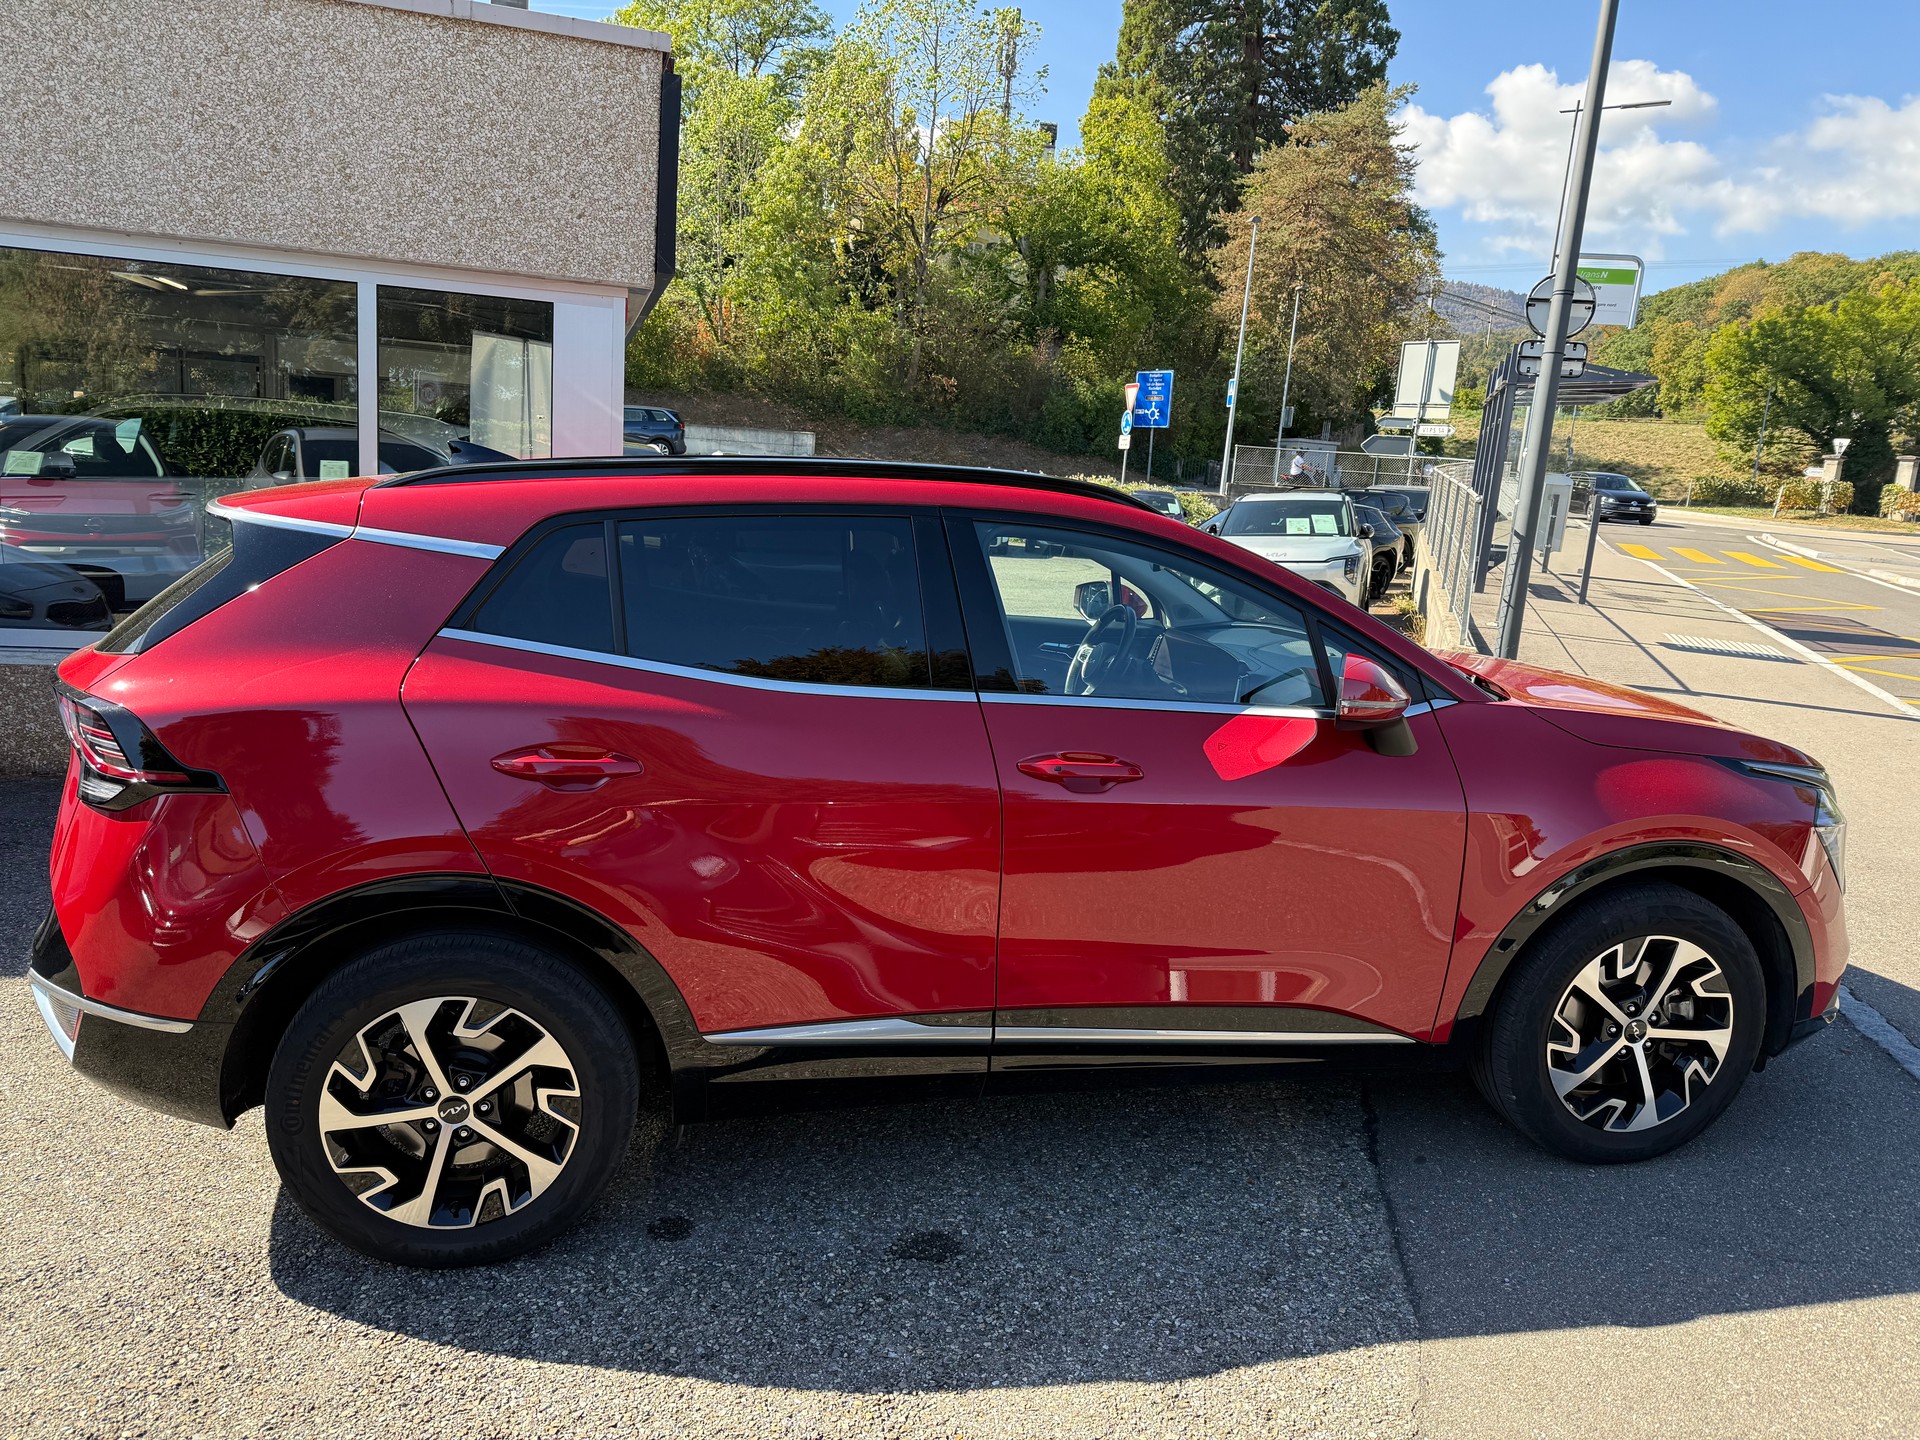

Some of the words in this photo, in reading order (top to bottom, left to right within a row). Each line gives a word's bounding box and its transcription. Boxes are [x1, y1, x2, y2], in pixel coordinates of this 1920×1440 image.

[1580, 270, 1608, 279] transN
[280, 1018, 335, 1137] Continental
[440, 1104, 467, 1118] KIA
